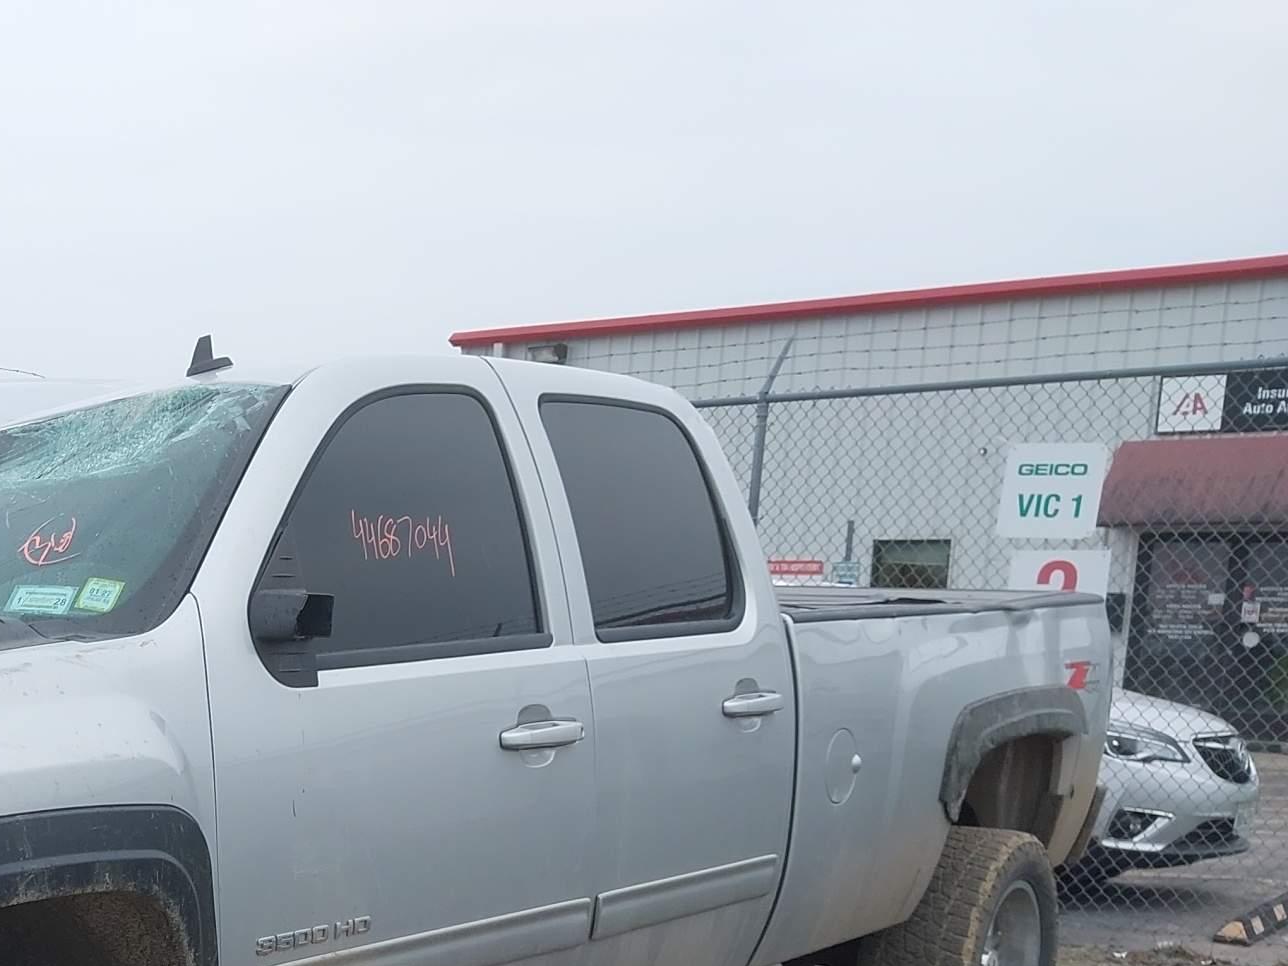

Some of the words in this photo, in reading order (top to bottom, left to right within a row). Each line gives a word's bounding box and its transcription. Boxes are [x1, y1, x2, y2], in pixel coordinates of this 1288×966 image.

[1243, 402, 1274, 415] Auto
[1276, 400, 1288, 414] A
[1018, 463, 1088, 476] GEICO
[1018, 493, 1061, 518] VIC
[1071, 494, 1083, 518] 1
[351, 509, 455, 577] 44687044
[334, 915, 371, 940] HD
